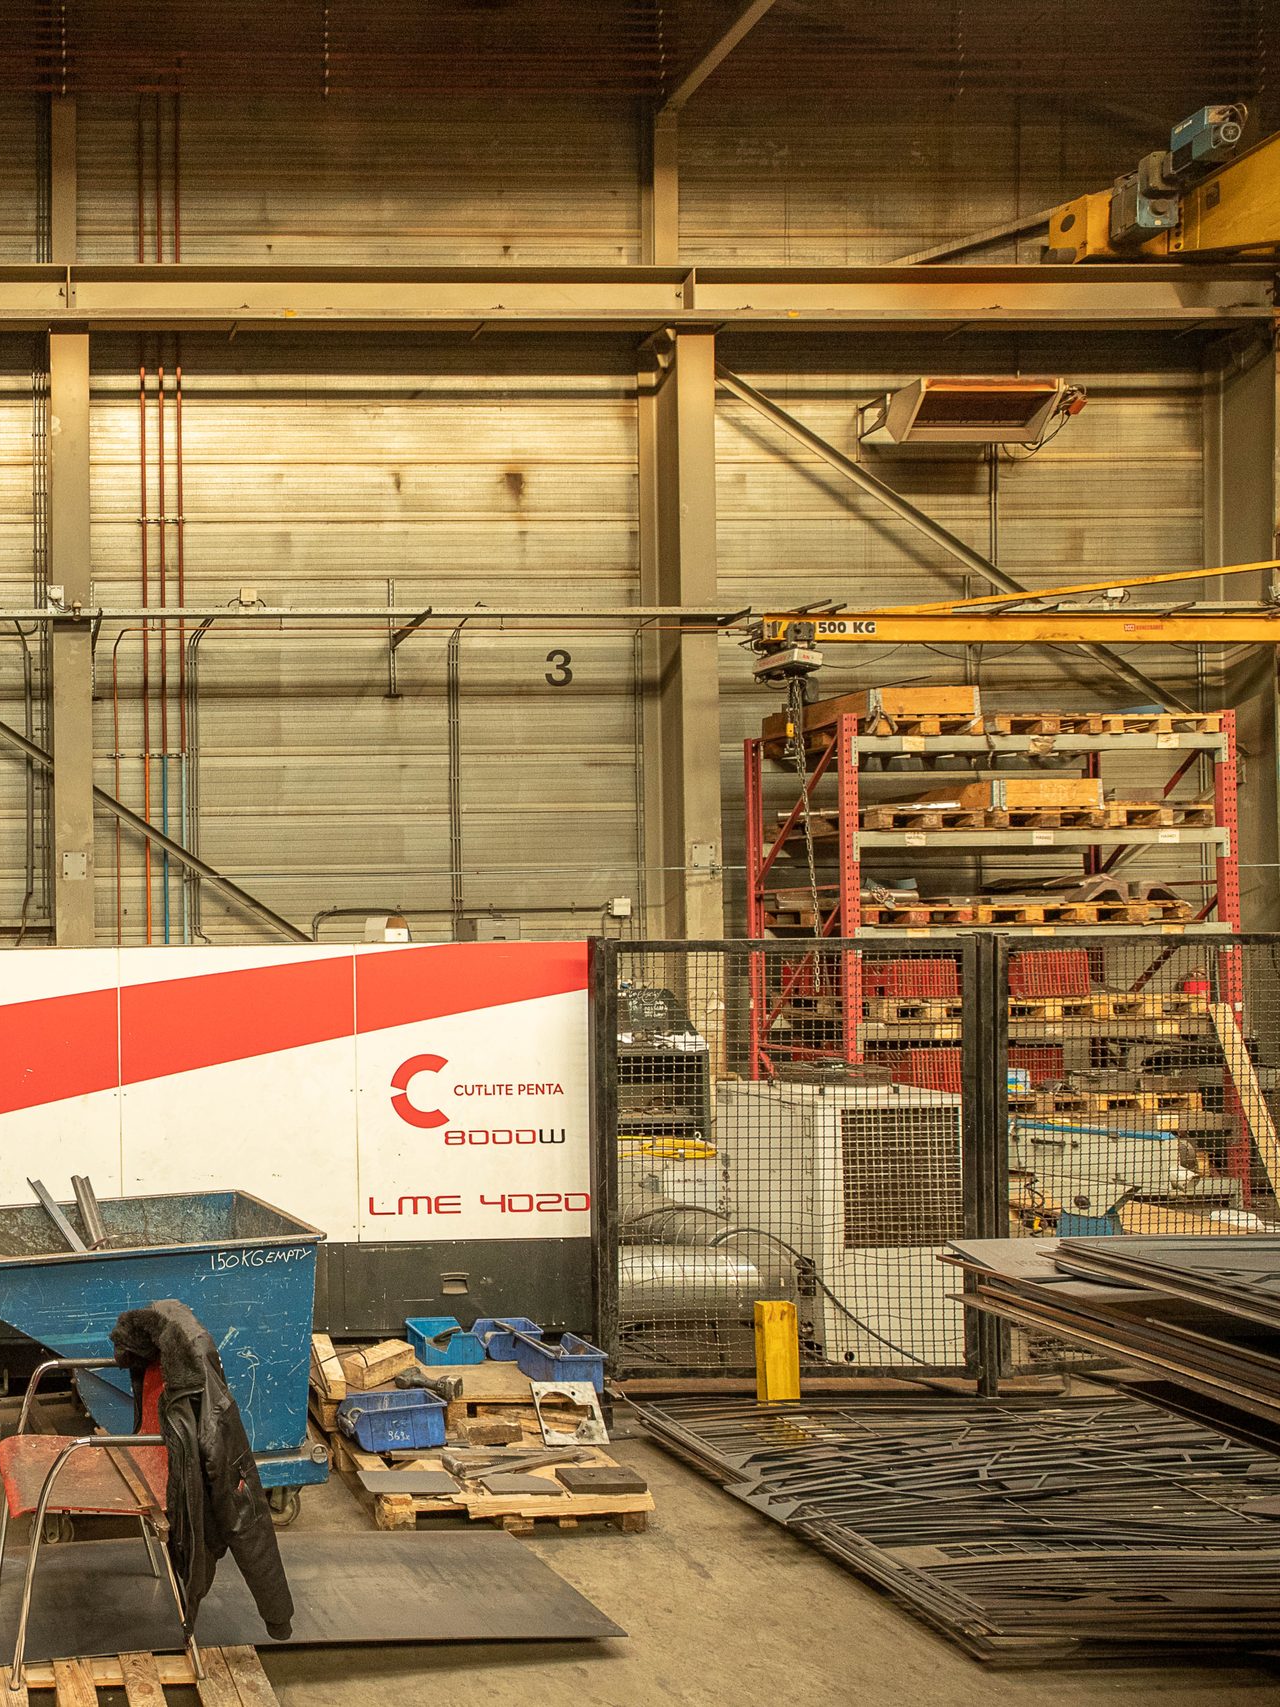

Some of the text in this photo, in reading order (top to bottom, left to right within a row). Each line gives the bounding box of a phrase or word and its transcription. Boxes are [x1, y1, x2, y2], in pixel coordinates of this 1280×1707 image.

[818, 621, 876, 634] 500 KG
[545, 649, 573, 687] 3
[453, 1083, 564, 1096] CUTLITE PENTA
[444, 1128, 566, 1145] 8000W
[369, 1192, 590, 1215] LME 4020
